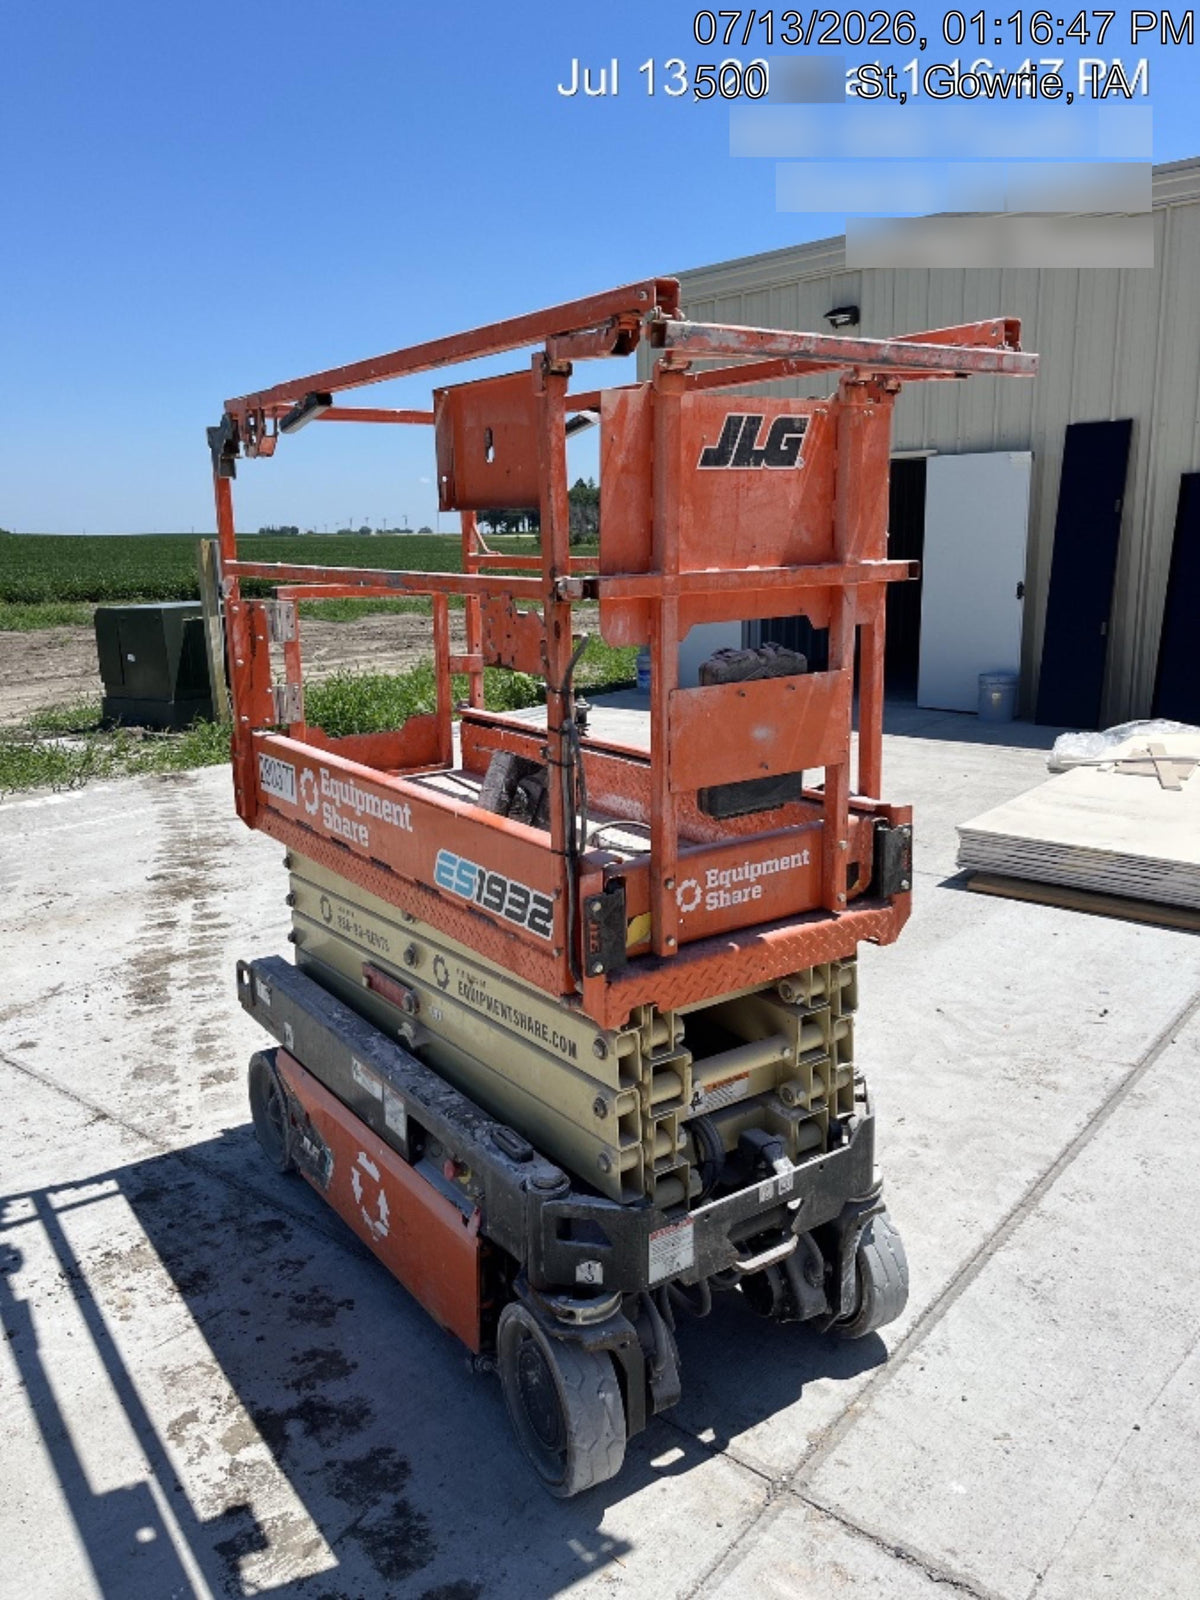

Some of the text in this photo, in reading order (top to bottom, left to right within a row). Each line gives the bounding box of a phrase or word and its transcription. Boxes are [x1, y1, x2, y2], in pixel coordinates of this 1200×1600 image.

[697, 412, 811, 470] JLG
[320, 767, 414, 833] Equipment
[322, 801, 369, 848] Share
[434, 848, 554, 941] ES1932
[705, 848, 810, 888] Equipment
[705, 884, 762, 911] Share
[457, 979, 578, 1060] EQUIPMENTSHARE.COM
